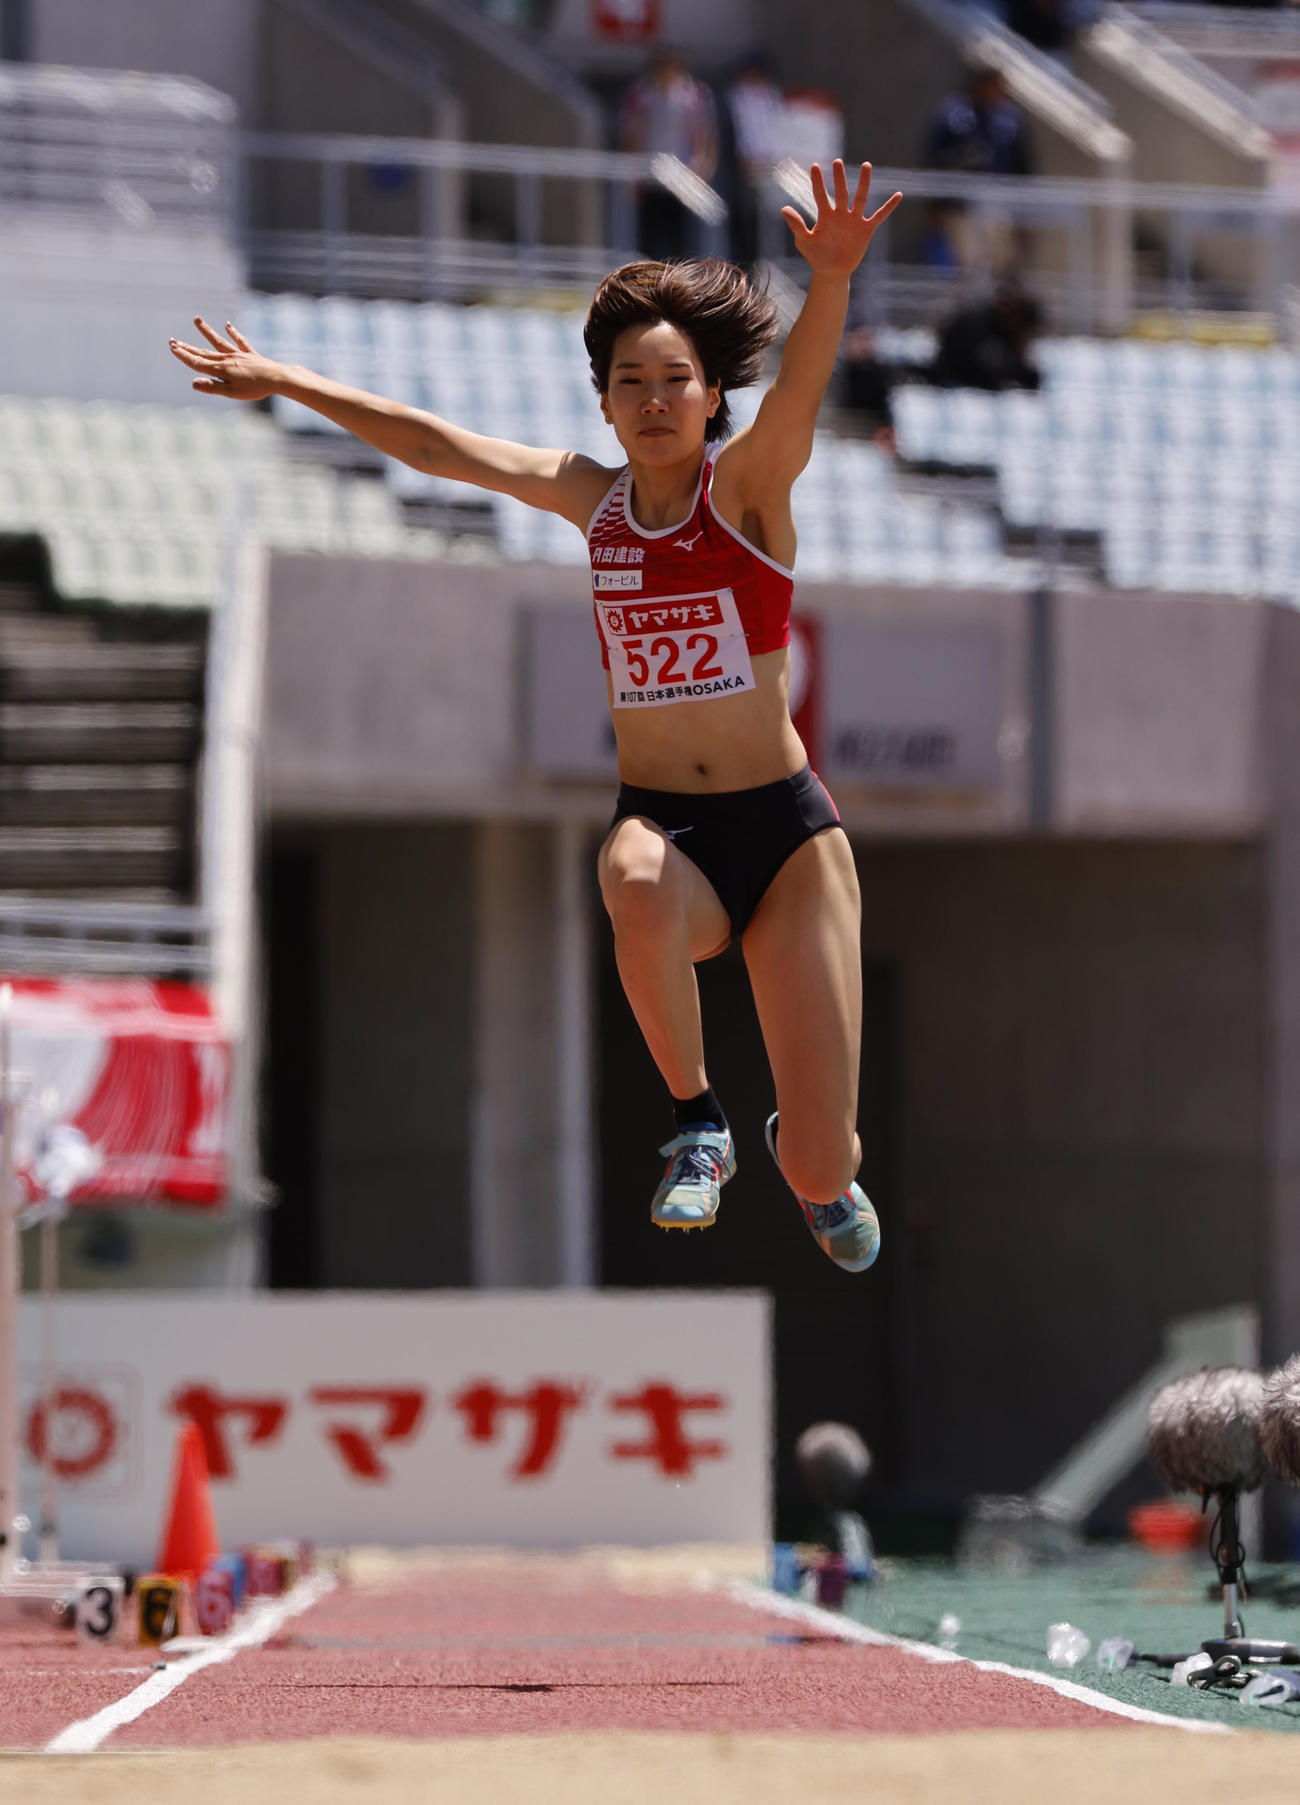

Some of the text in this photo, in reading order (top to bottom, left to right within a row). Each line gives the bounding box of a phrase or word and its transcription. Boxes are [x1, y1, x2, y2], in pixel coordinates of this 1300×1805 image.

[601, 575, 639, 586] フォービル
[628, 604, 715, 629] ヤマザキ
[621, 633, 724, 687] 522
[170, 1376, 730, 1482] ヤマザキ
[84, 1585, 115, 1637] 3
